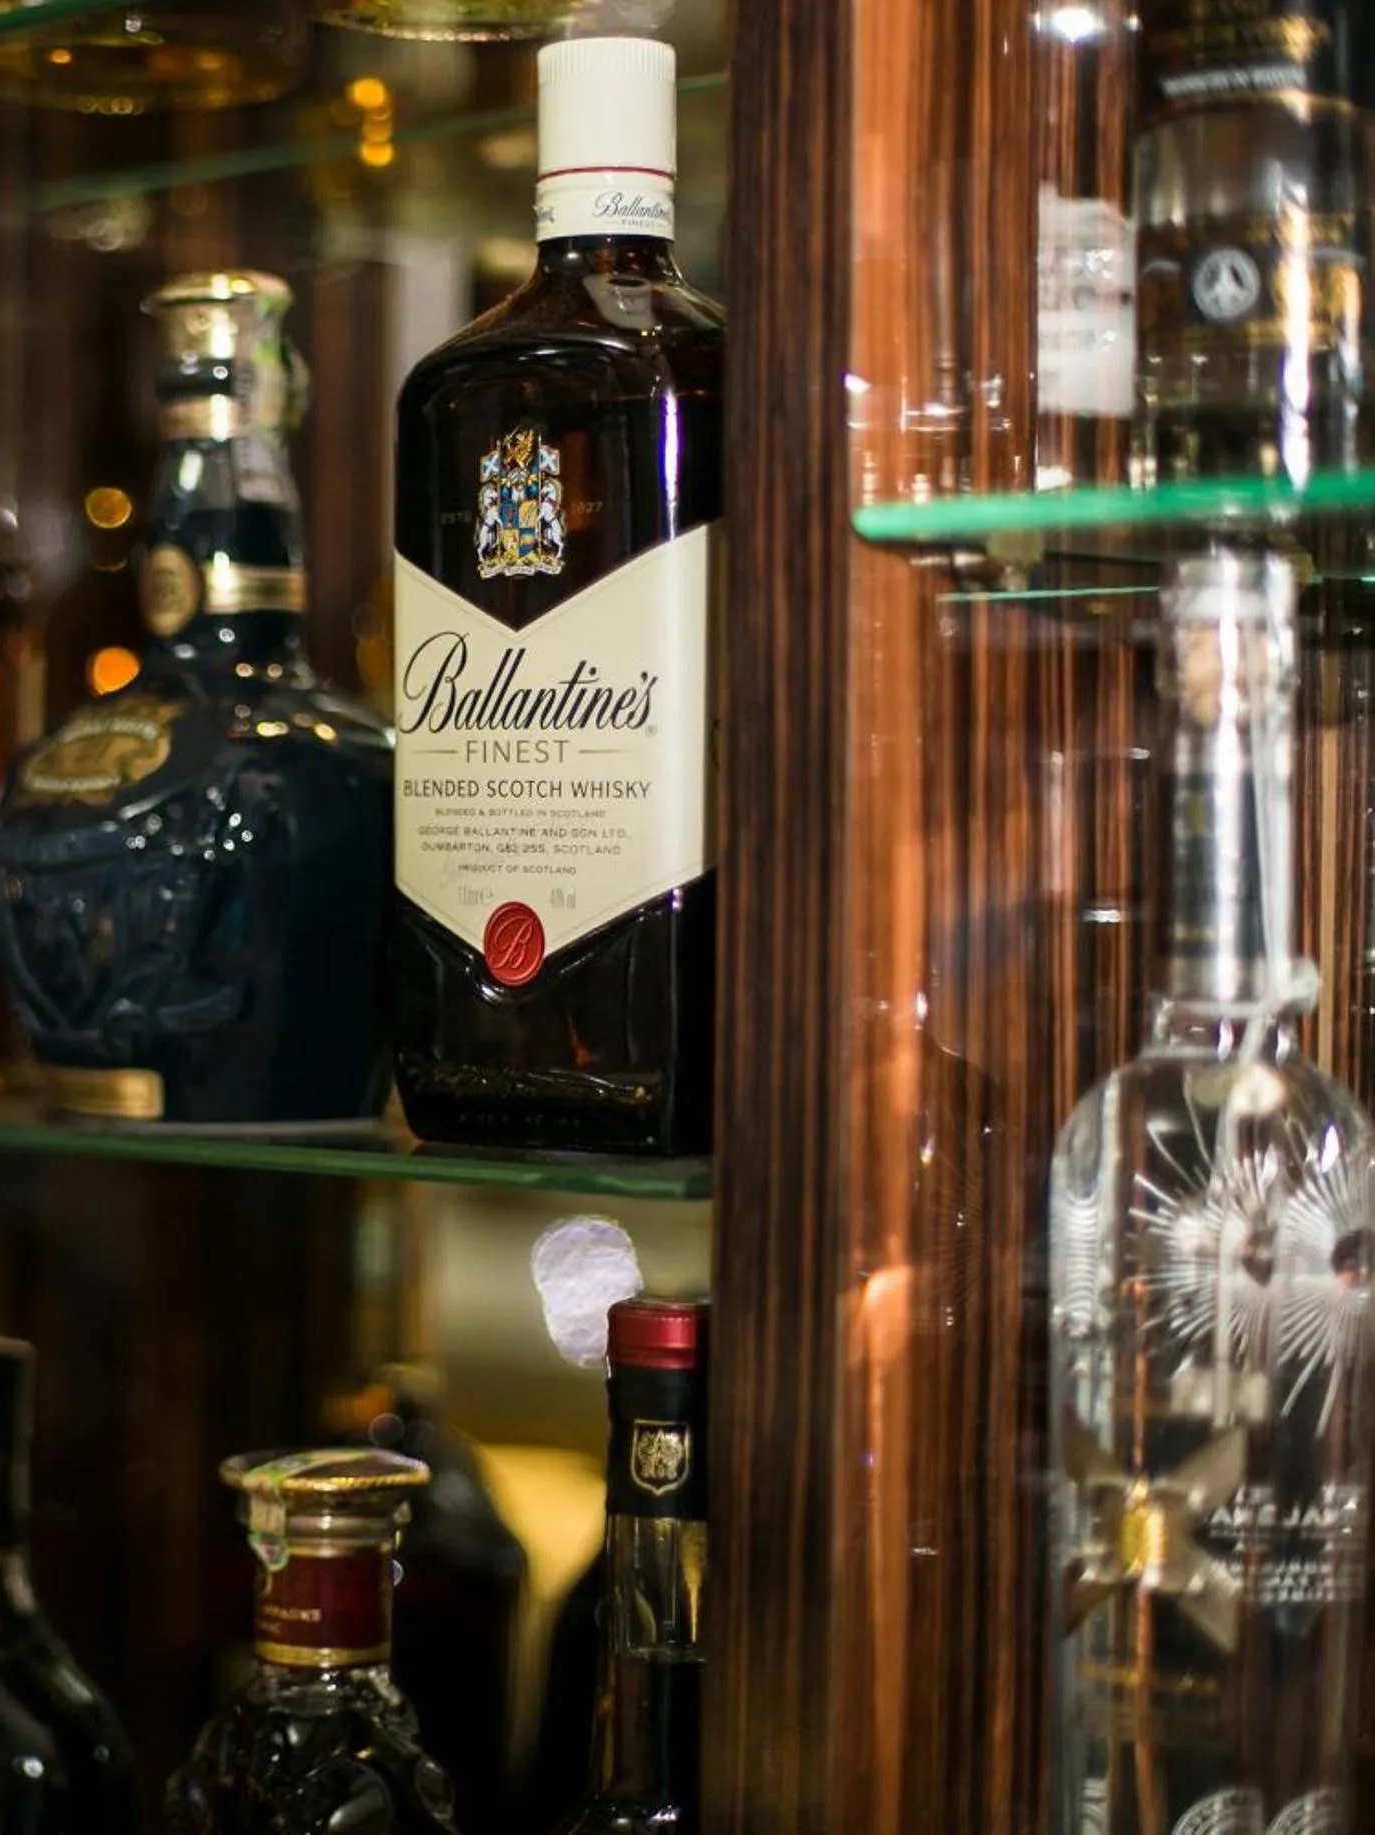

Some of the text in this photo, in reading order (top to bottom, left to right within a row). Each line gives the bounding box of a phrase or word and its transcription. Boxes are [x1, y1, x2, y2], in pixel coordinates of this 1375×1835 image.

[398, 631, 658, 734] Ballantine's
[465, 739, 570, 764] FINEST
[403, 779, 652, 799] BLENDED SCOTCH WHISKY
[488, 808, 534, 817] BOTTLED
[549, 809, 607, 818] SCOTLAND
[418, 826, 459, 836] GEORGE
[463, 826, 536, 837] BALLANTINE
[541, 827, 568, 838] AND
[571, 827, 598, 838] SON
[553, 844, 622, 856] SCOTLAND
[458, 864, 577, 874] PRODUCT OF SCOTLAND
